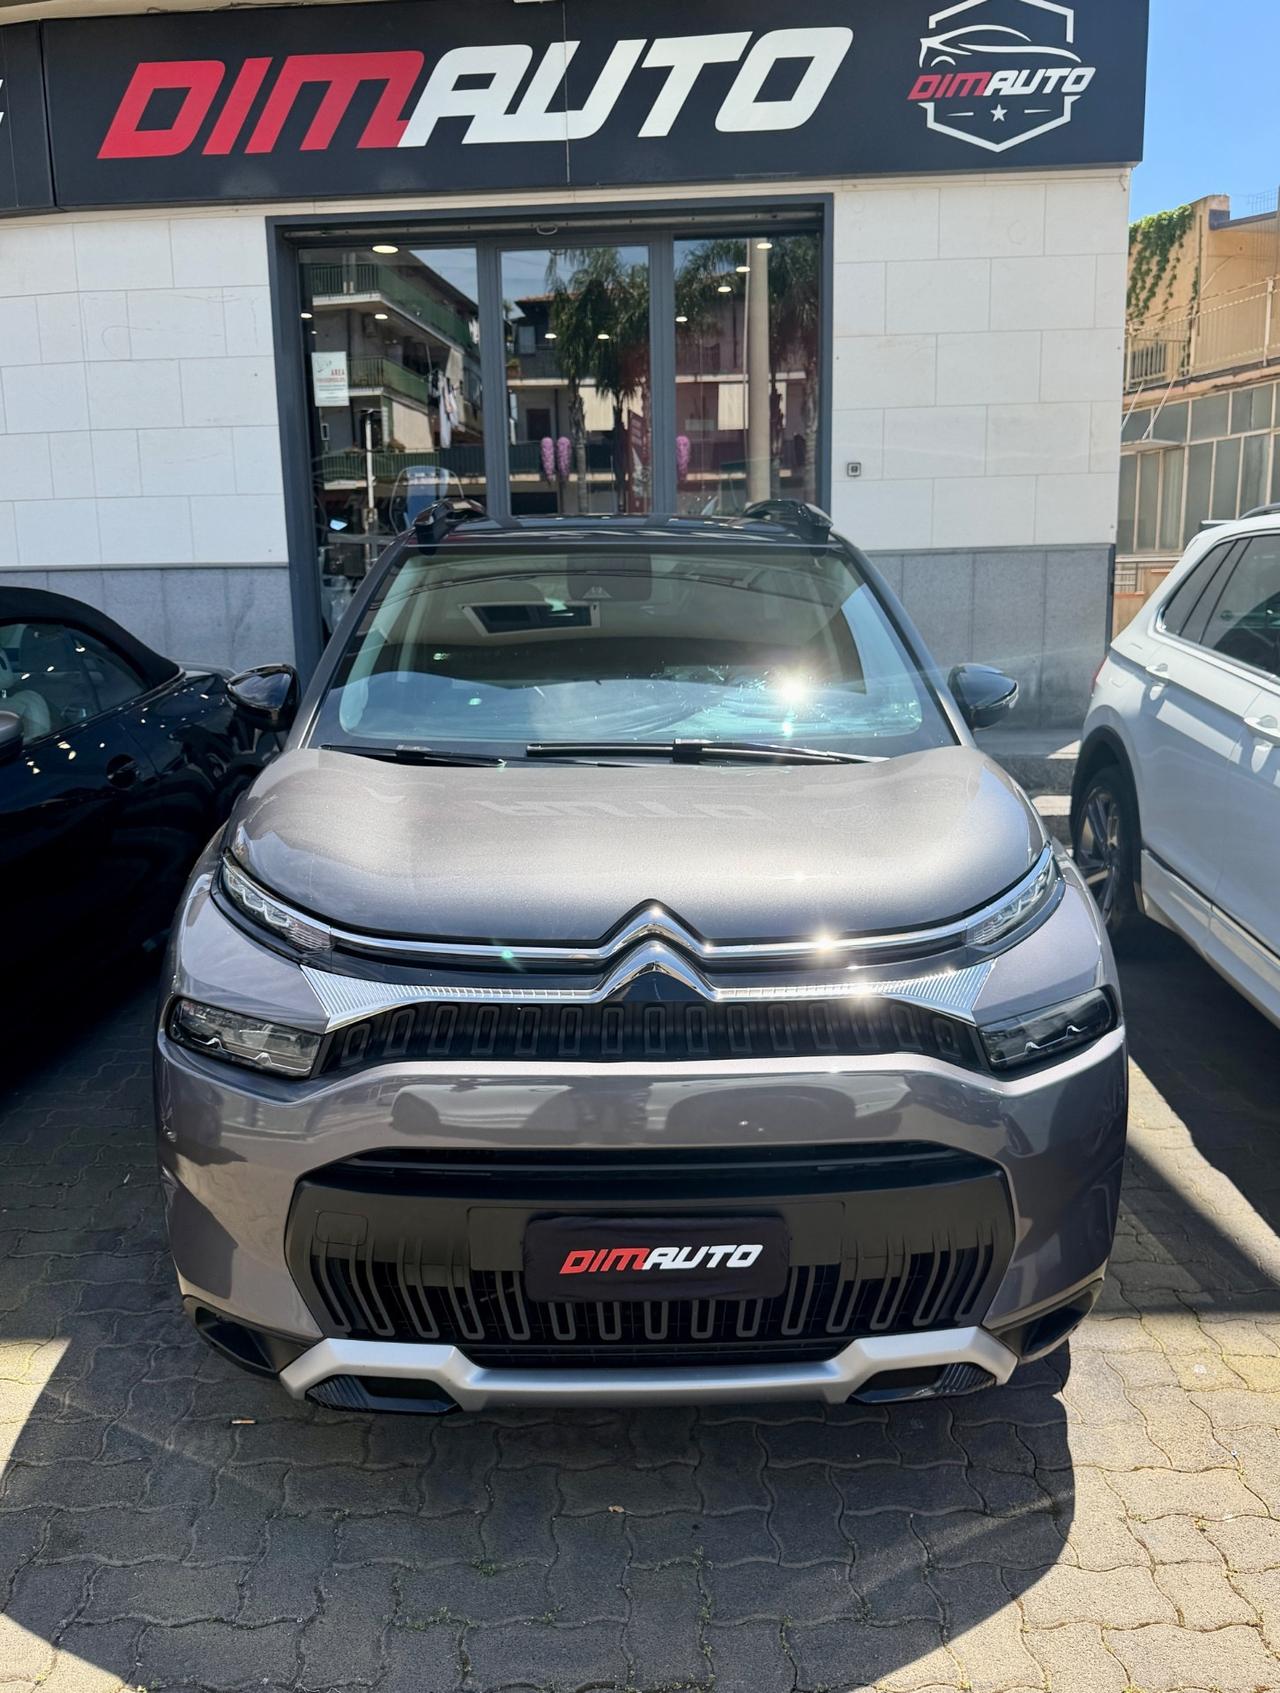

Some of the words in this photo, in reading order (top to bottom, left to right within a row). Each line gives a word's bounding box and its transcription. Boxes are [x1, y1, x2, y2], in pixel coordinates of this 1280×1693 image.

[97, 27, 854, 159] DIMAUTO
[907, 67, 1096, 100] DIMAUTO
[559, 1245, 763, 1275] DIMAUTO
